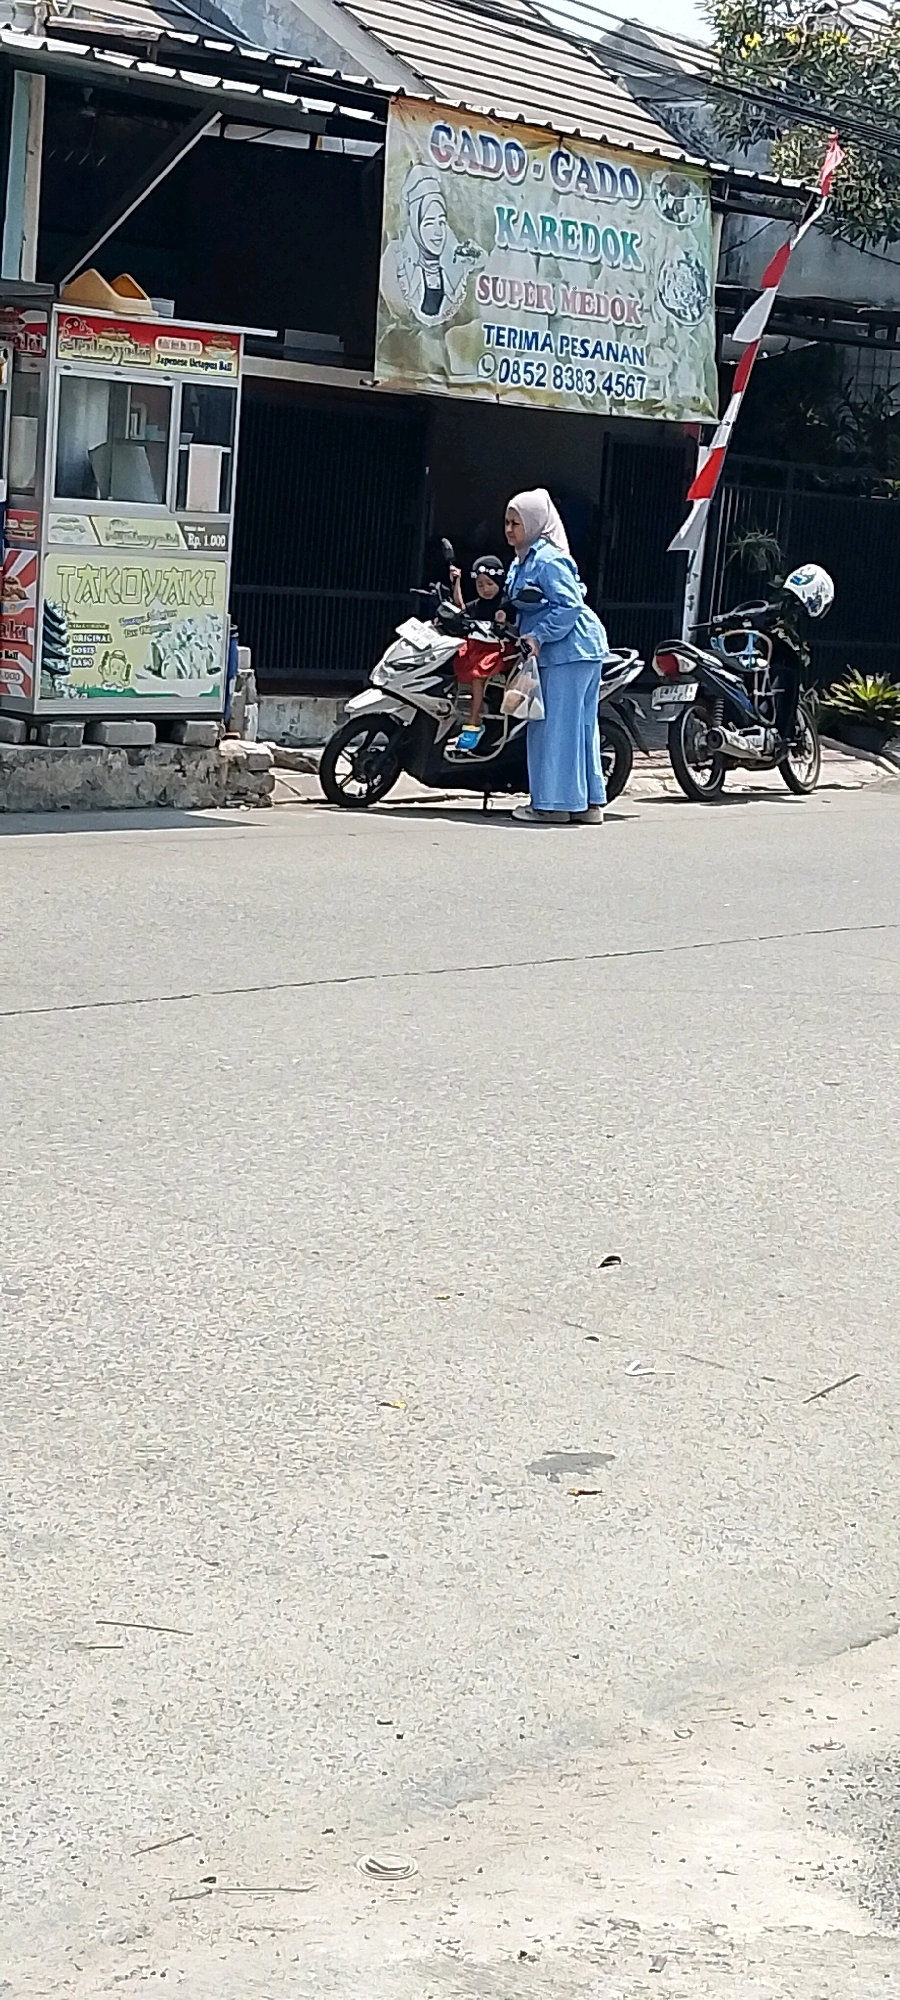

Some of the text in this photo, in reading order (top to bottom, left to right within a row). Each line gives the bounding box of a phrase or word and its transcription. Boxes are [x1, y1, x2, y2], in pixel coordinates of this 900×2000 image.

[432, 123, 527, 182] GADO
[550, 150, 642, 203] GADO
[495, 206, 642, 268] KAREDOK
[478, 275, 642, 325] SUPER MEDOK
[484, 325, 645, 366] TERIMA PESANAN
[499, 358, 646, 399] 0852 8383 4567
[204, 535, 226, 547] 1.000
[57, 564, 216, 606] TAKOYAKI
[72, 646, 95, 654] SOSIS
[73, 634, 111, 642] ORIGINAL
